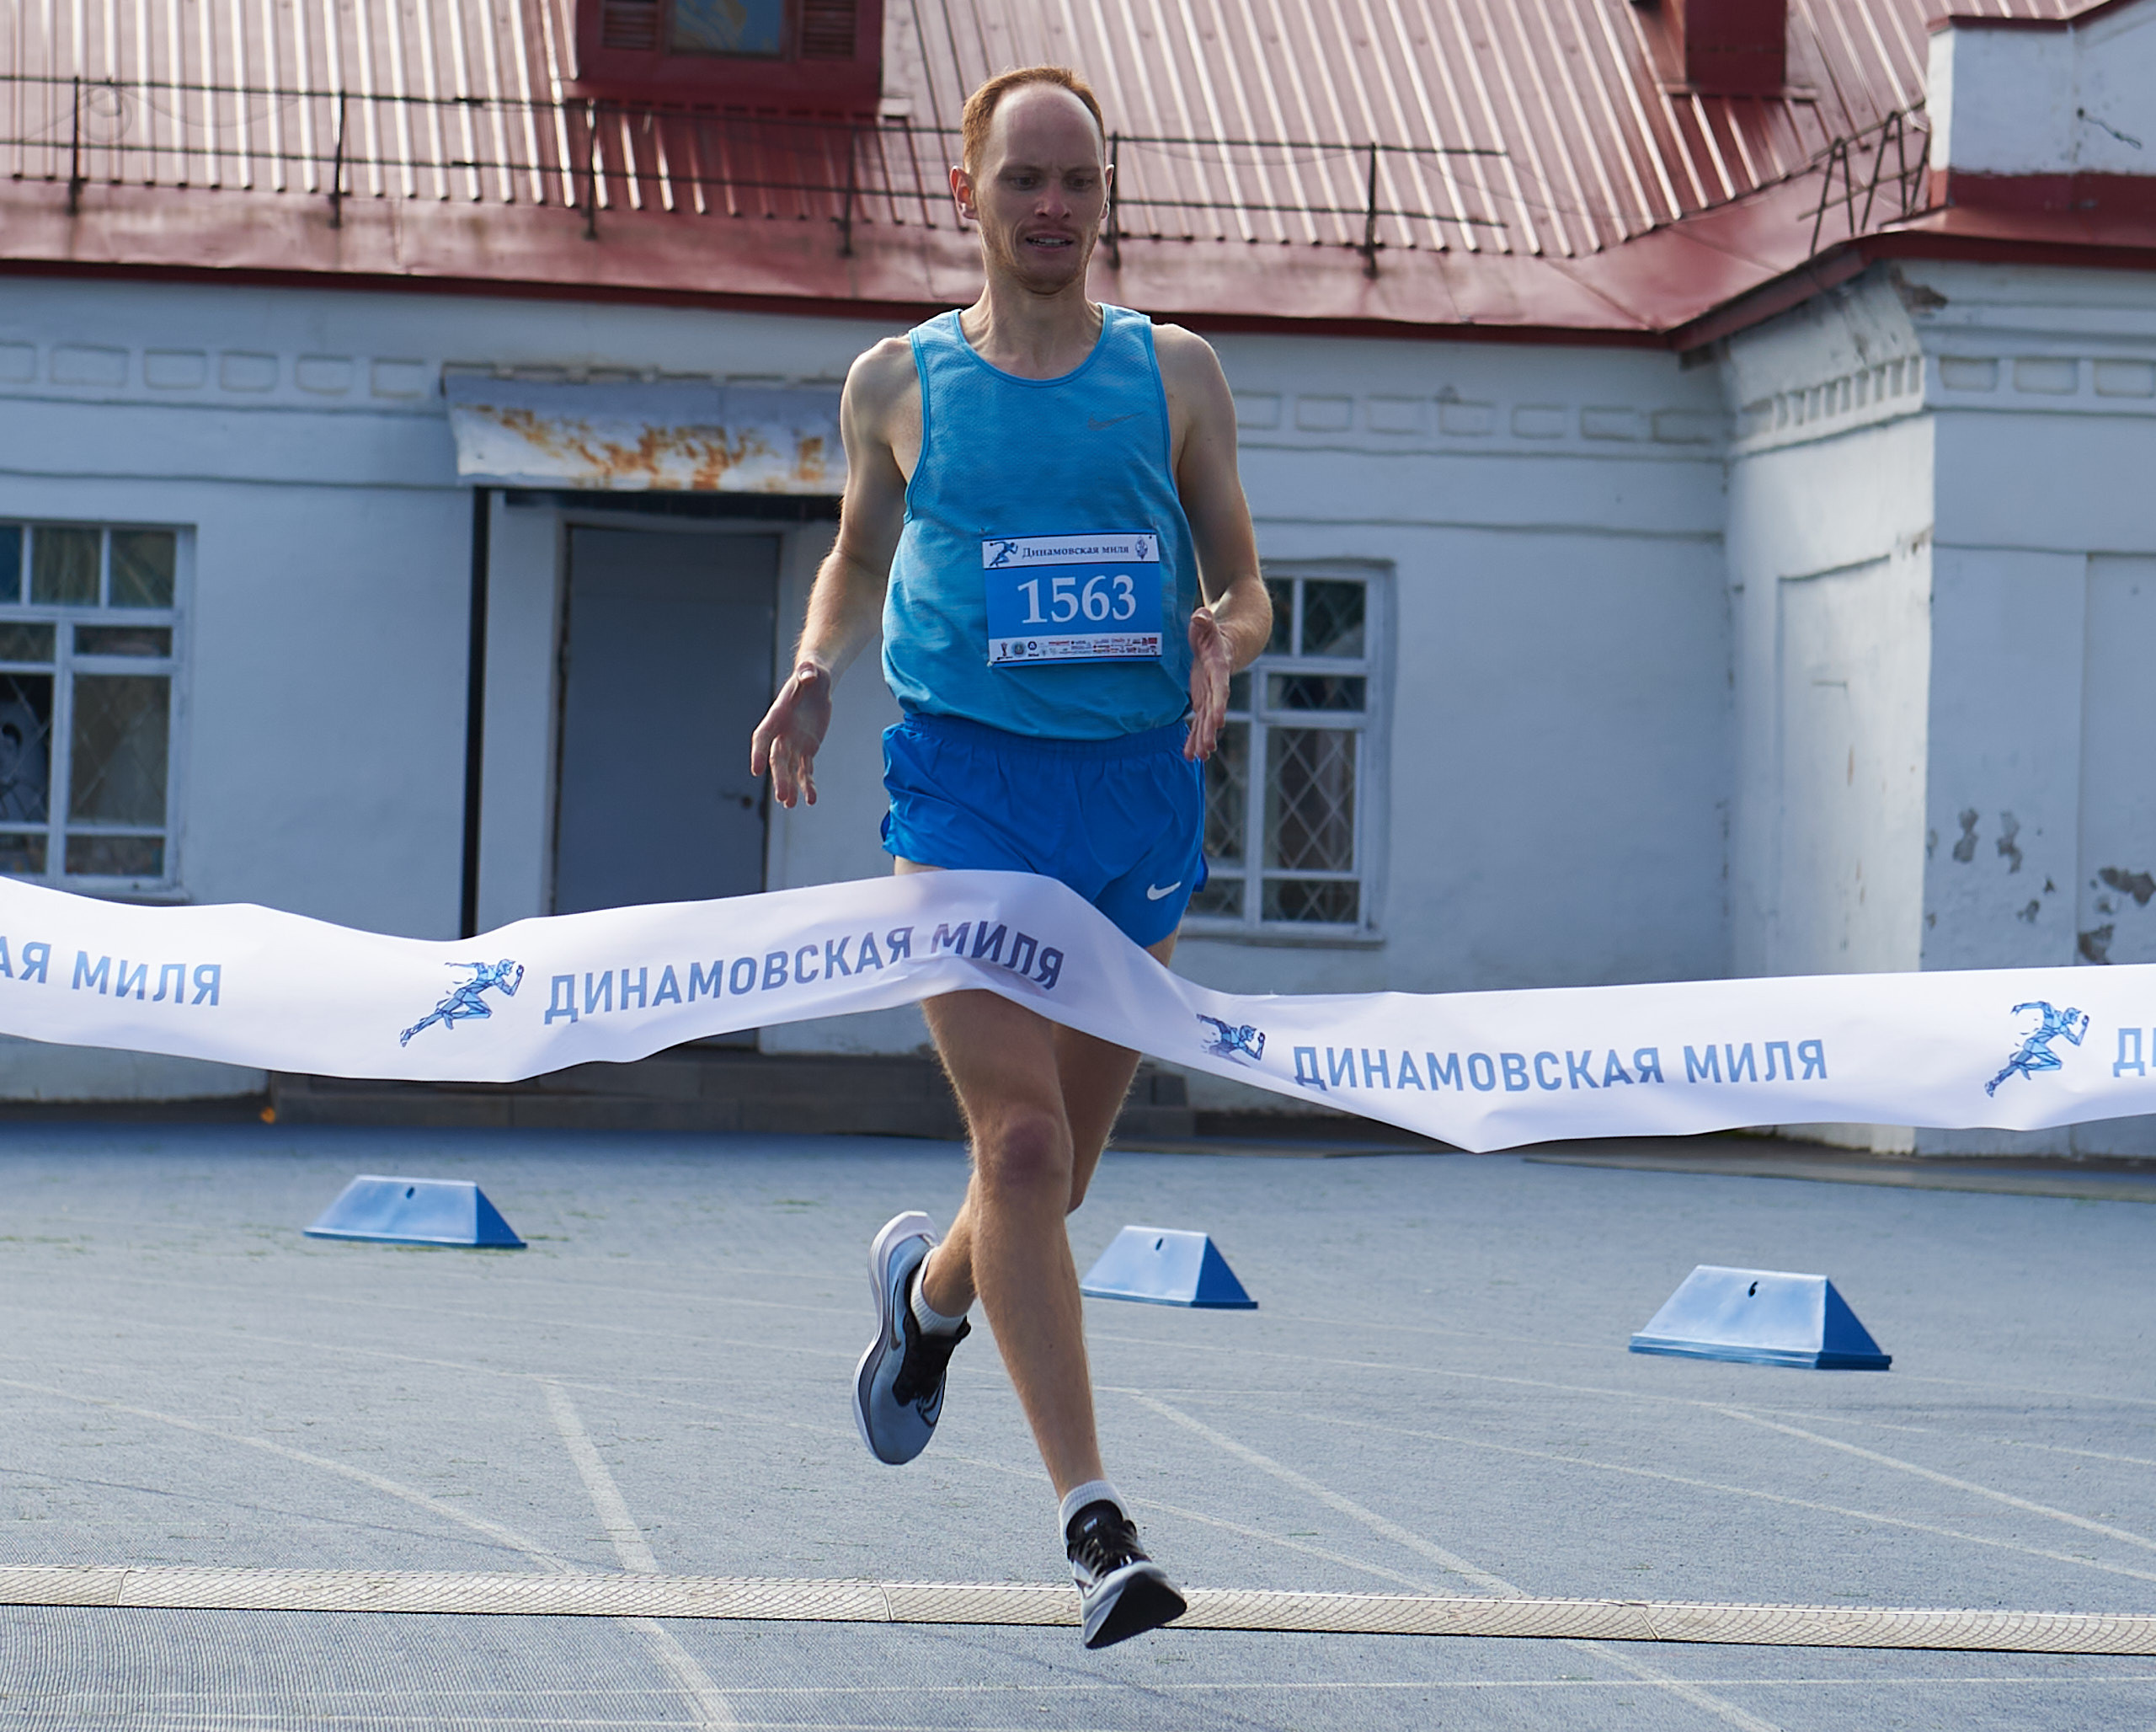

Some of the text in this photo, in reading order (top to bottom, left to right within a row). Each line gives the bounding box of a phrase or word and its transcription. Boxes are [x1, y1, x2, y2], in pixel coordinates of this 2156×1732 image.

[1022, 546, 1129, 559] Динамовская миля
[1017, 575, 1137, 623] 1563
[72, 950, 222, 1007] МИЛЯ
[544, 921, 1065, 1024] ДИНАМОВСКАЯ МИЛЯ
[1293, 1039, 1828, 1092] ДИНАМОВСКАЯ МИЛЯ
[2113, 1027, 2156, 1078] Д
